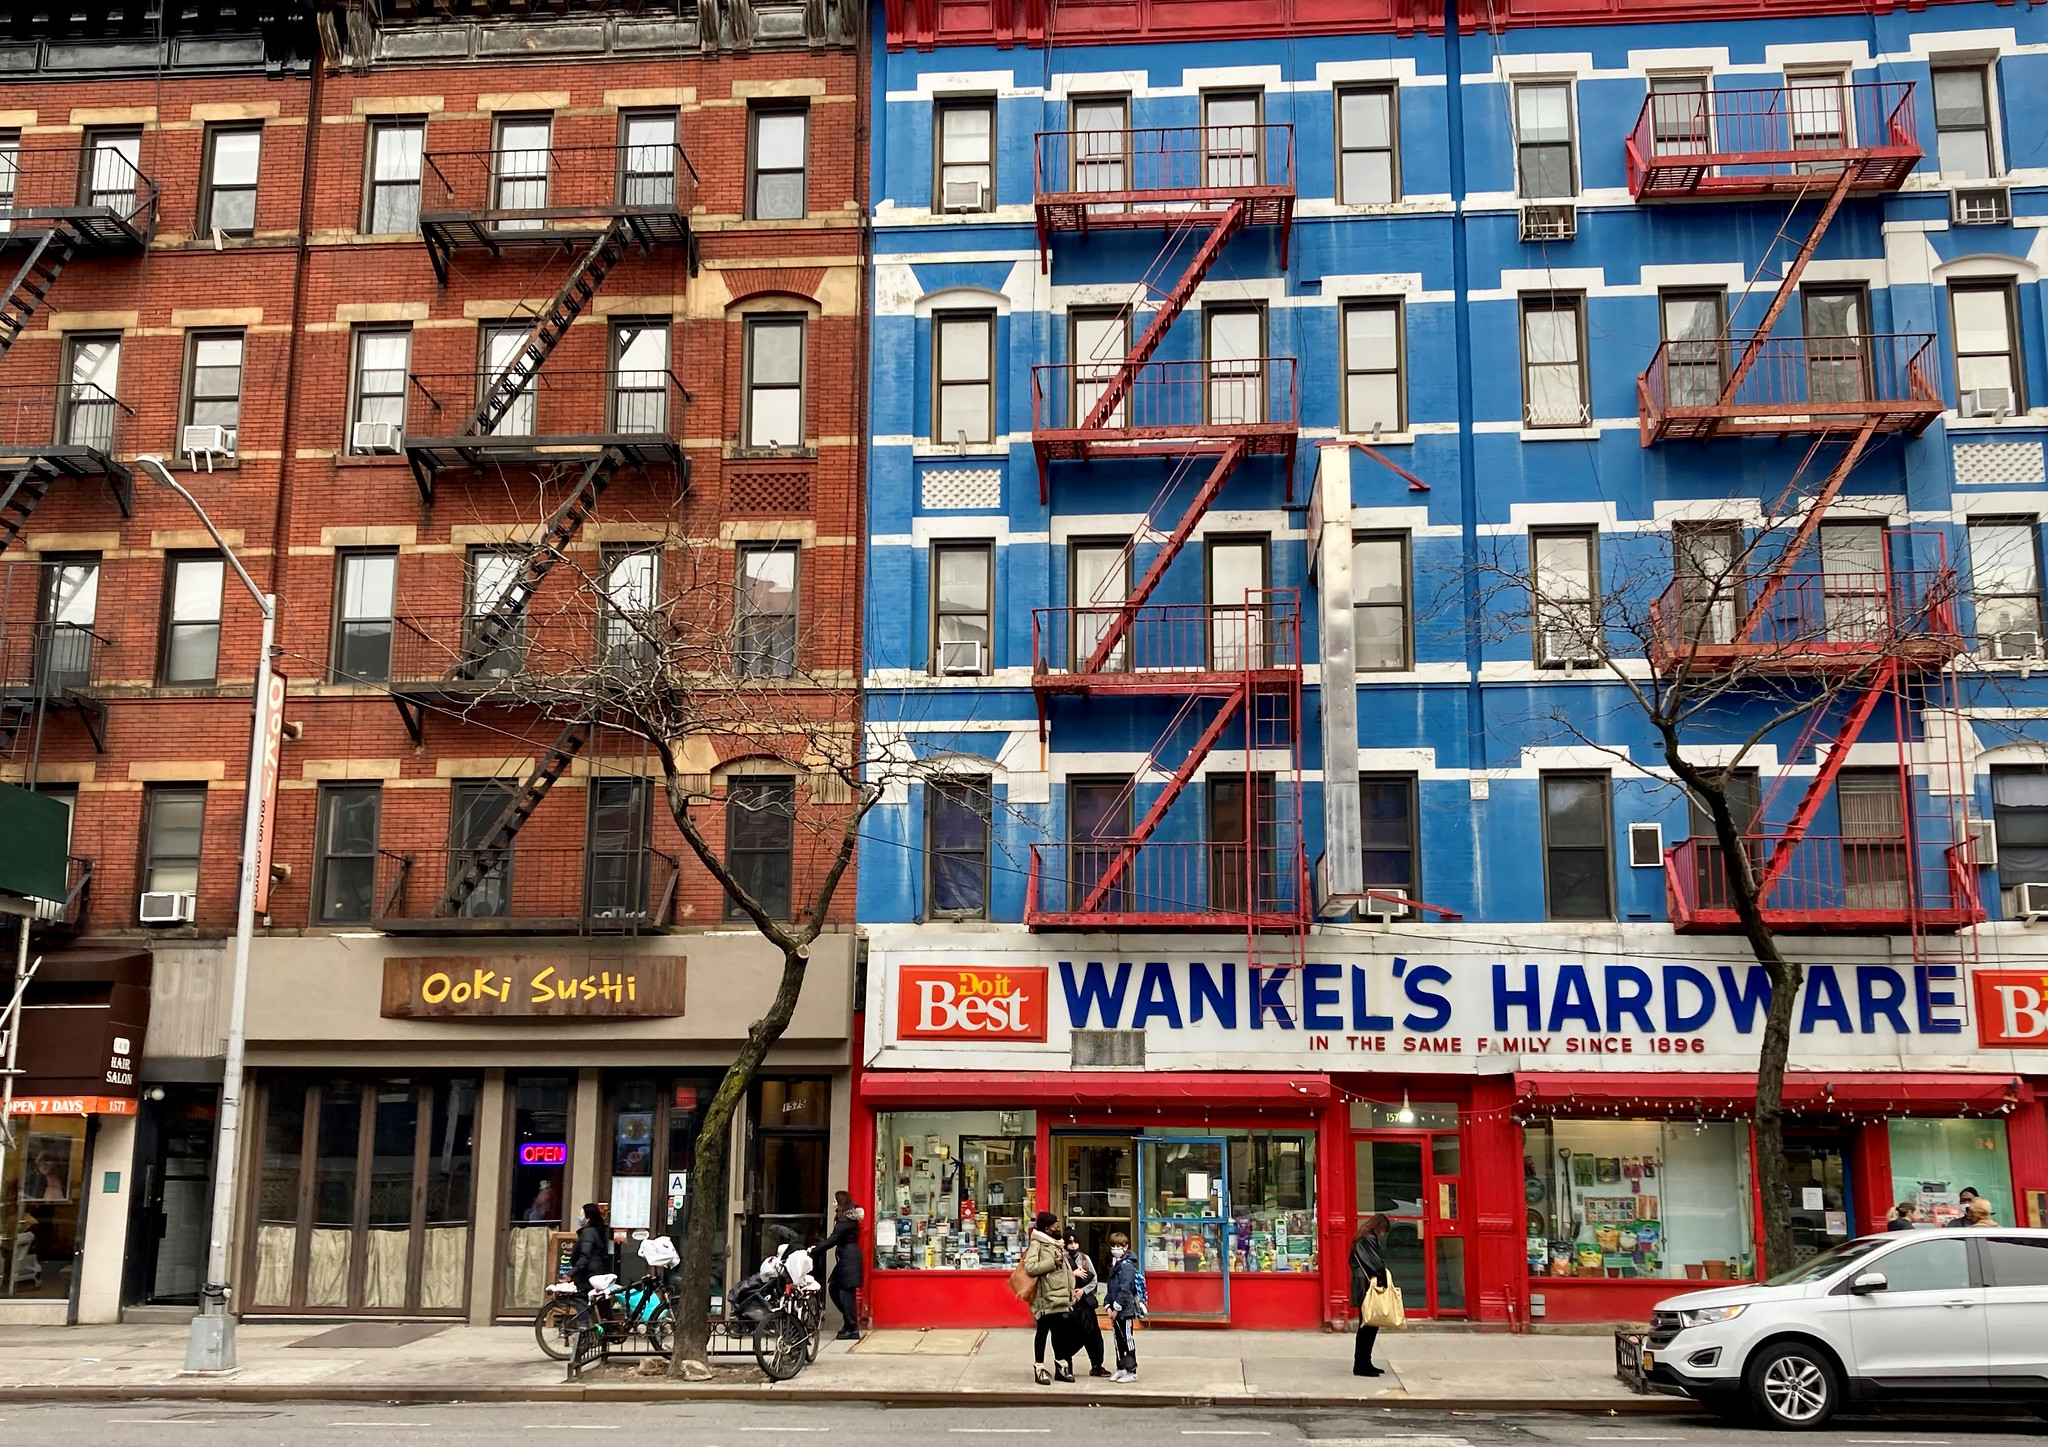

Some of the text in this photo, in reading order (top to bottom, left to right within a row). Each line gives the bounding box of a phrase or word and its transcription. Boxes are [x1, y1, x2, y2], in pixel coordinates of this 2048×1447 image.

[958, 972, 1011, 996] Do it
[1058, 957, 1961, 1034] WANKEL'S HARDWARE
[915, 980, 1029, 1032] Best
[1309, 1036, 1706, 1053] IN THE SAME FAMILY SINCE 1896
[110, 1056, 131, 1070] HAIR
[105, 1071, 133, 1085] SALON
[40, 1100, 48, 1112] 7
[52, 1100, 84, 1112] DAYS
[109, 1100, 126, 1112] 1577
[524, 1147, 563, 1162] OPEN
[672, 1176, 683, 1190] A
